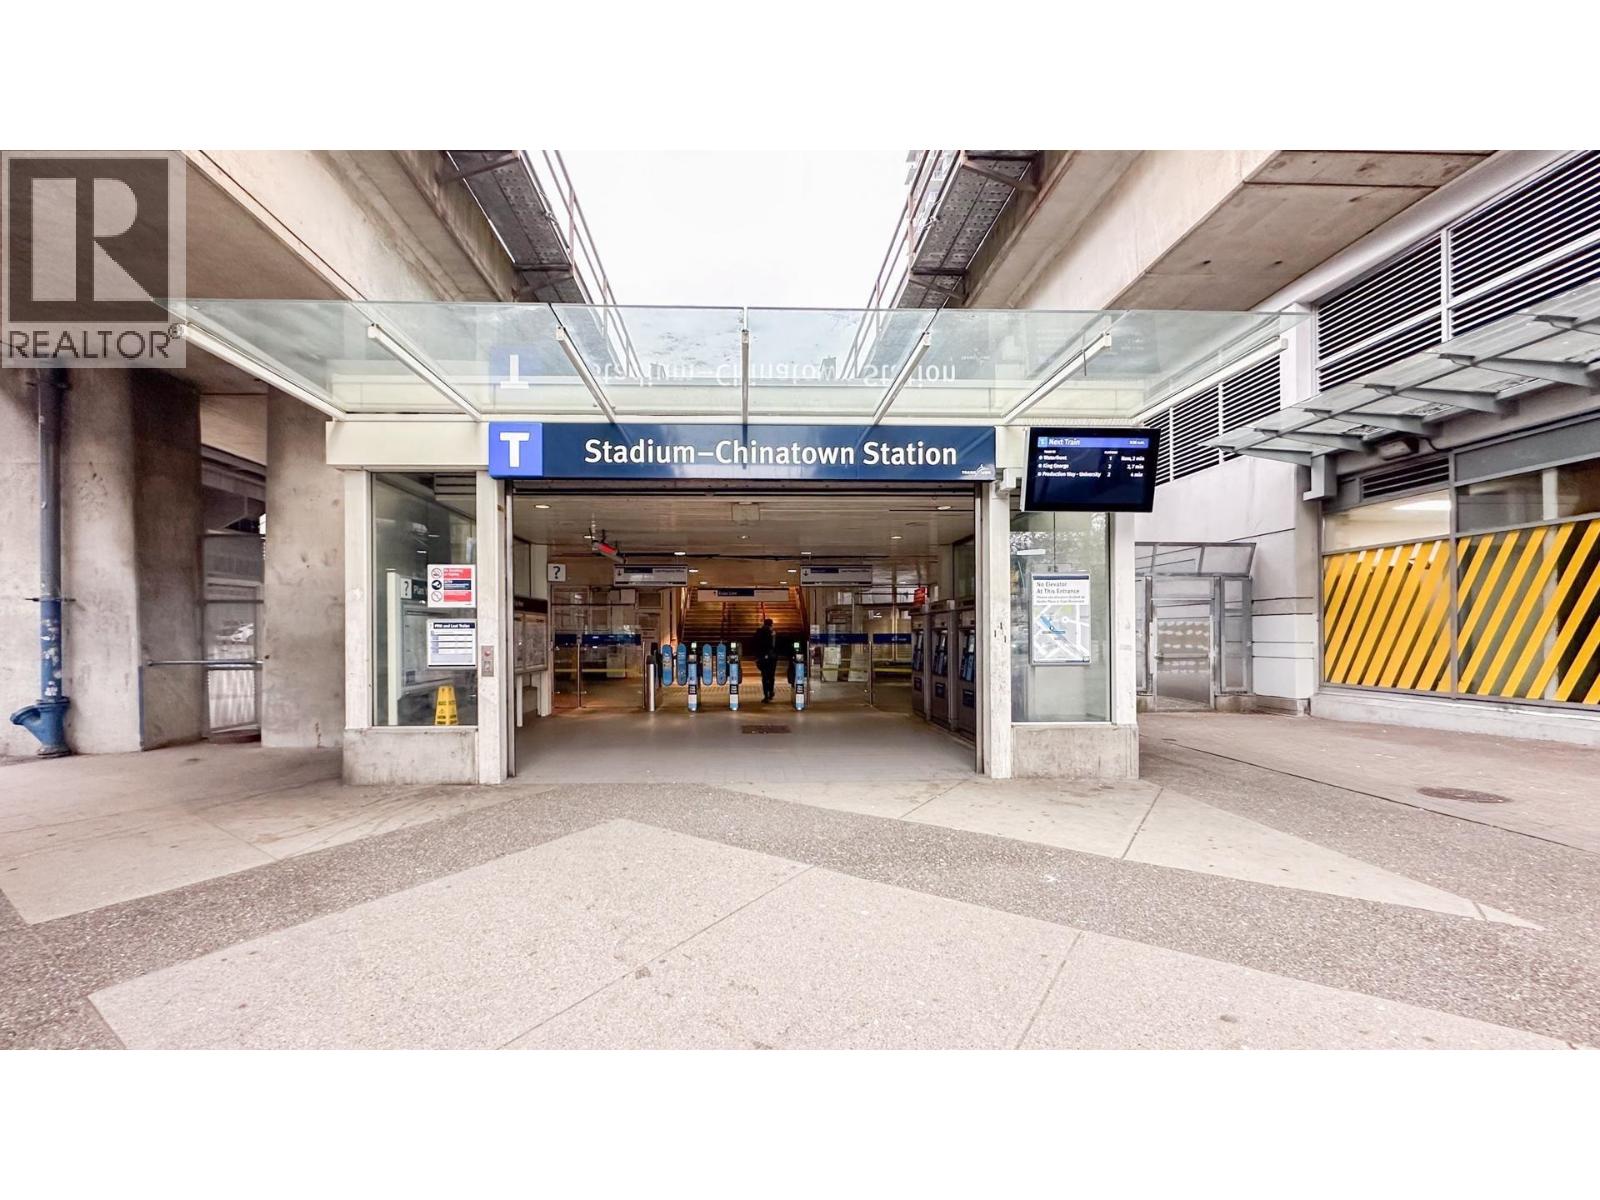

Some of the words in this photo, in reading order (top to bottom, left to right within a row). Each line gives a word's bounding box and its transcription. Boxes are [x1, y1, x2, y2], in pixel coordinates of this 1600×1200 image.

[500, 432, 530, 468] T
[863, 440, 957, 466] Station
[1048, 438, 1064, 446] Next
[1064, 437, 1081, 446] Train
